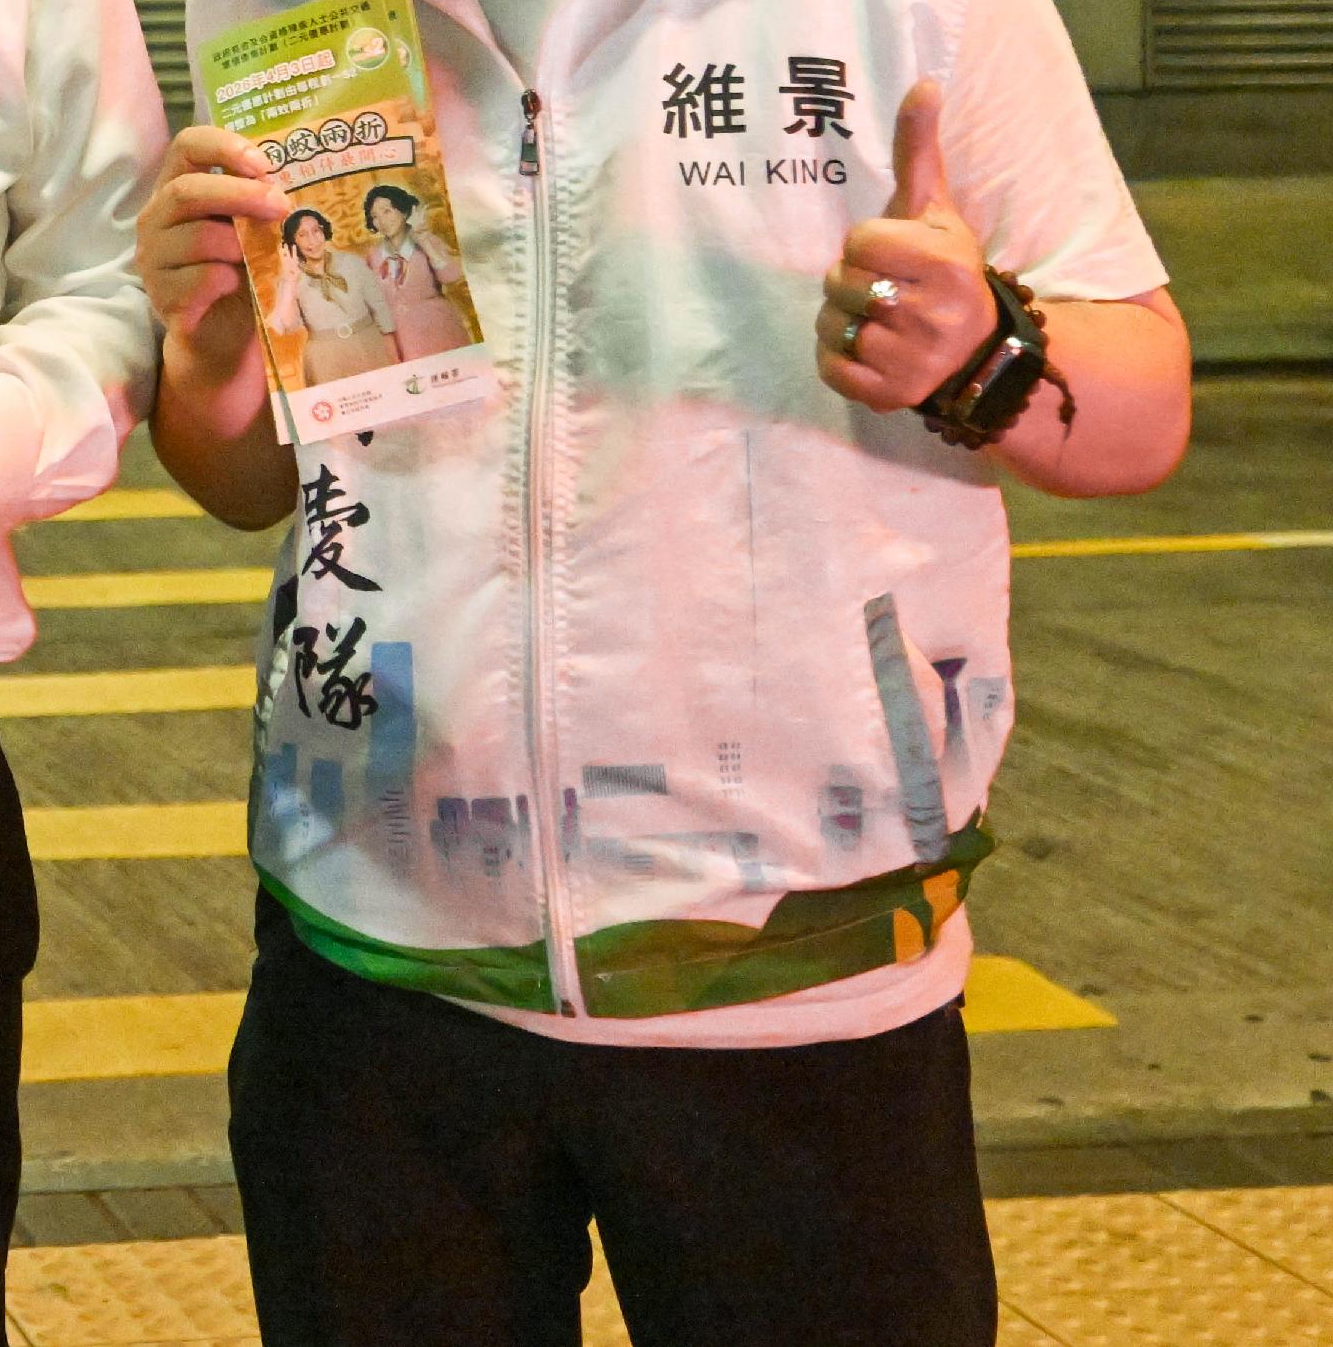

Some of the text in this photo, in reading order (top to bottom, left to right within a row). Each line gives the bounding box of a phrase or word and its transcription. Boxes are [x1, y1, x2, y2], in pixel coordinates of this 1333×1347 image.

[216, 49, 335, 103] 2026年4月3日起
[662, 56, 855, 139] 維景
[277, 147, 398, 186] 惠相伴最開心
[679, 158, 847, 186] WAI KING
